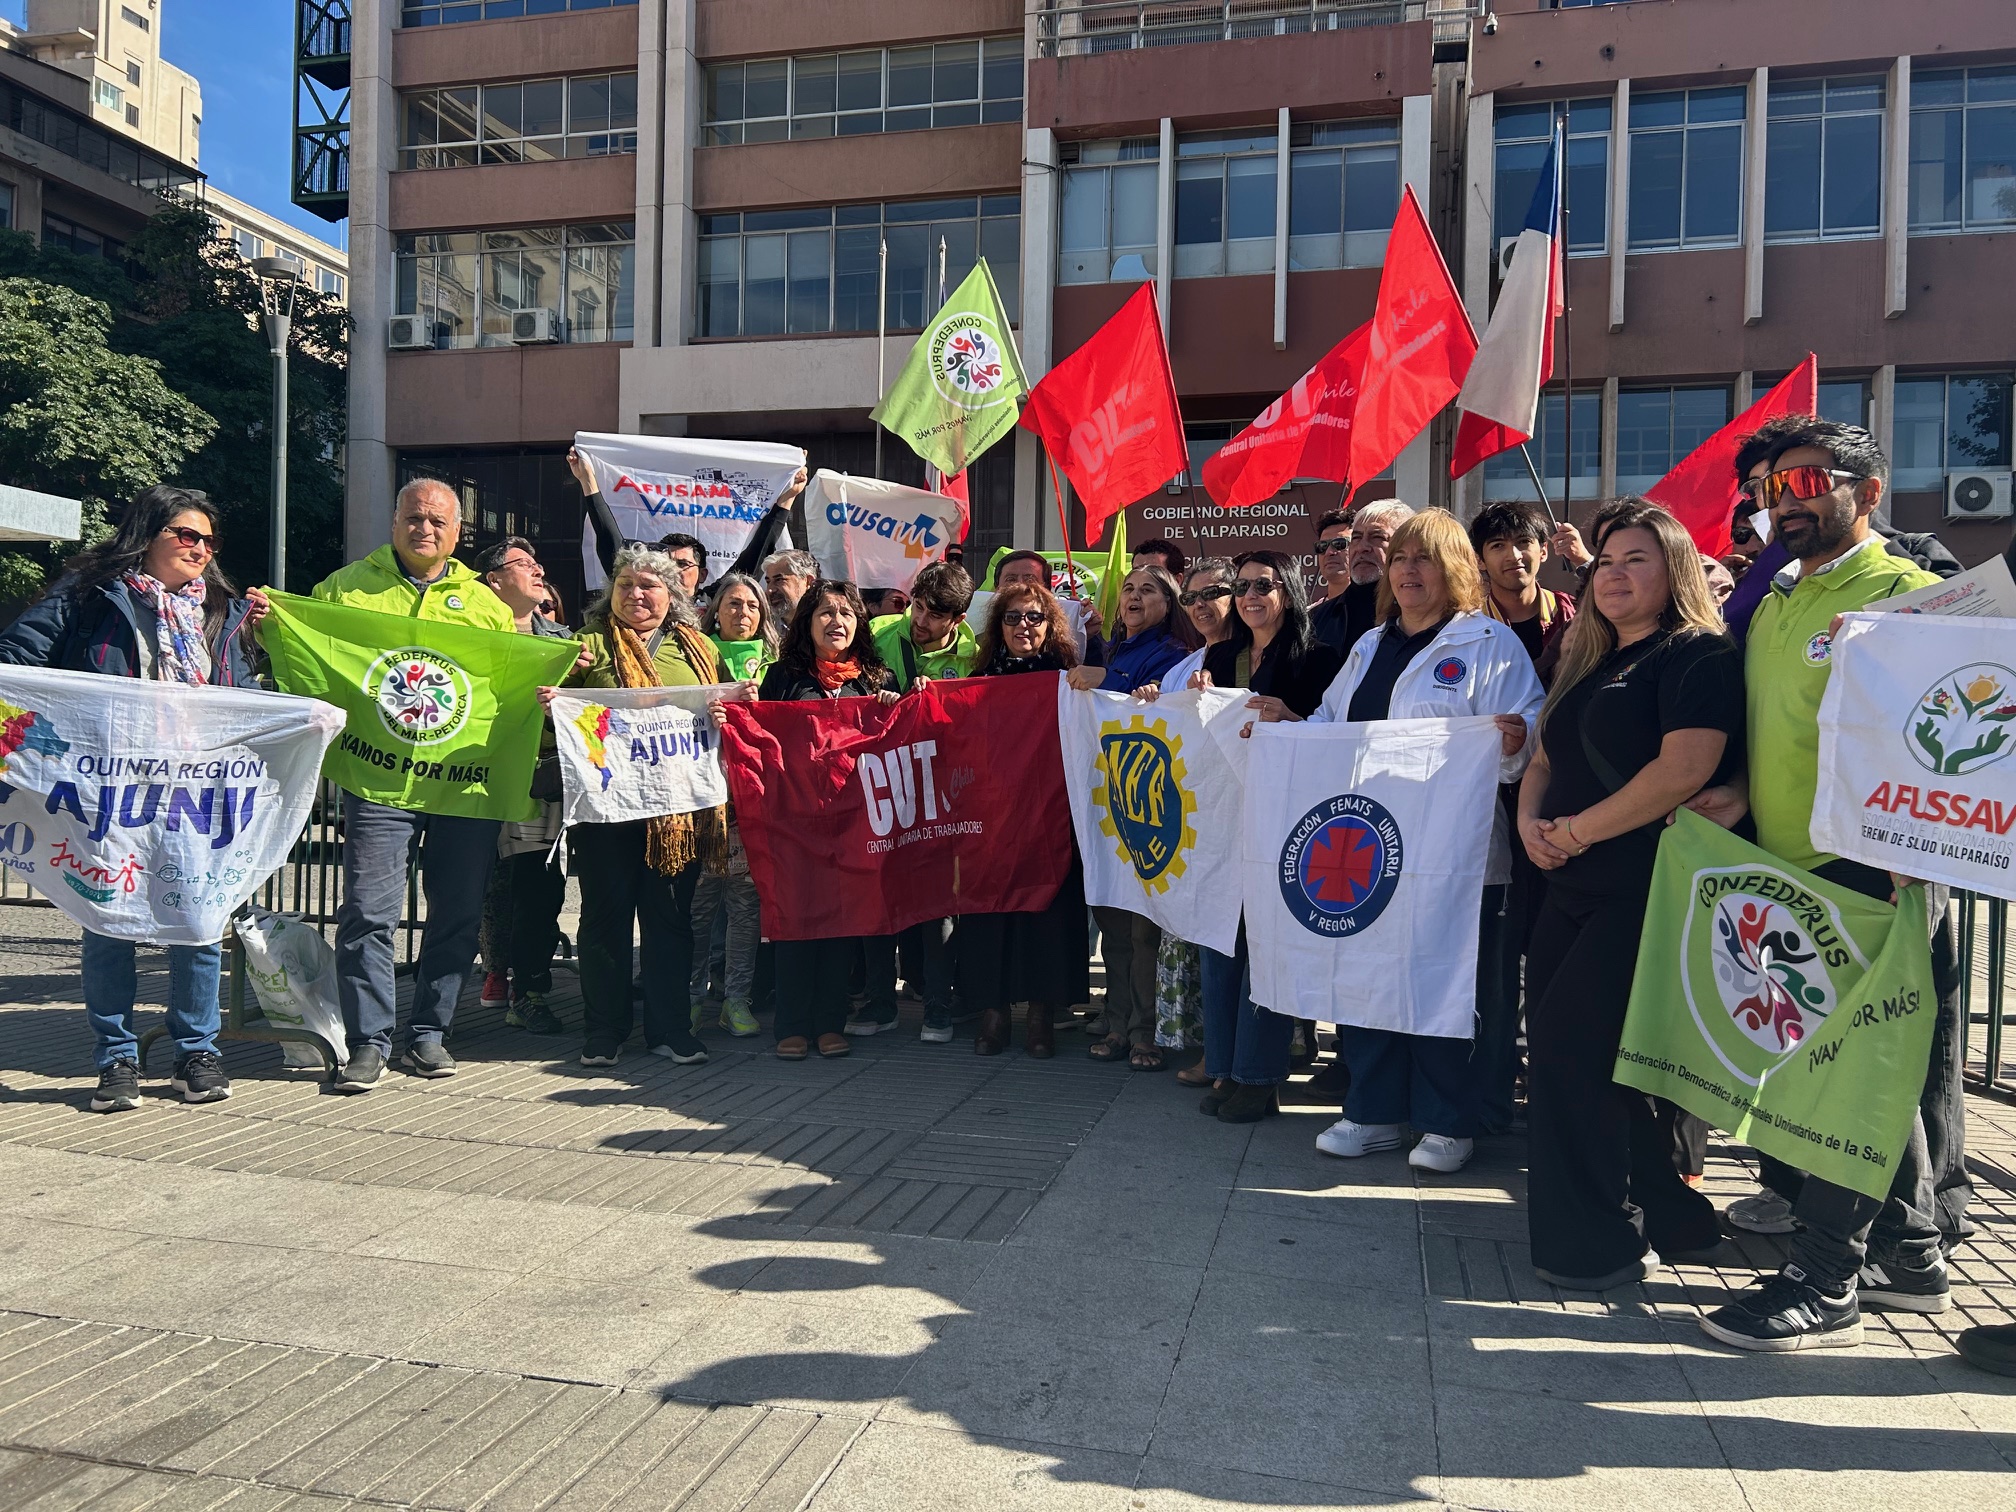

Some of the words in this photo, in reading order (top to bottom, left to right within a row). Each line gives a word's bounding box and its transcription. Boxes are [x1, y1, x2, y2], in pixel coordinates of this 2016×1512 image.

[1220, 438, 1247, 458] Central
[1286, 424, 1298, 439] de
[1143, 505, 1224, 520] GOBIERNO
[1229, 503, 1310, 518] REGIONAL
[1164, 526, 1185, 539] DE
[1190, 524, 1288, 539] VALPARAISO
[384, 651, 457, 676] FEDEPRUS
[636, 720, 674, 735] QUINTA
[629, 730, 710, 766] AJUNJI
[76, 754, 170, 779] QUINTA
[179, 755, 264, 779] REGIÓN
[401, 757, 443, 780] POR
[447, 762, 490, 783] MÁS!
[857, 740, 937, 836] CUT
[45, 781, 258, 850] AJUNJI
[866, 840, 895, 854] CENTRAL
[922, 826, 933, 840] DE
[934, 821, 983, 838] TRABAJADORES
[1284, 813, 1322, 883] FEDERACIÓN
[1330, 797, 1373, 816] FENATS
[1378, 818, 1399, 878] UNITARIA
[1890, 832, 1905, 846] DE
[1941, 843, 2010, 870] VALPARAÍSO
[1931, 826, 2014, 856] FUNCIONARIOS
[1308, 910, 1317, 921] V
[1317, 916, 1356, 932] REGIÓN
[1848, 1003, 1880, 1032] OR
[1882, 986, 1920, 1021] MÁS!
[1677, 1064, 1731, 1102] Democrática
[1732, 1095, 1742, 1107] de
[1825, 1134, 1841, 1150] de
[1844, 1139, 1859, 1156] la
[1859, 1263, 1891, 1287] N
